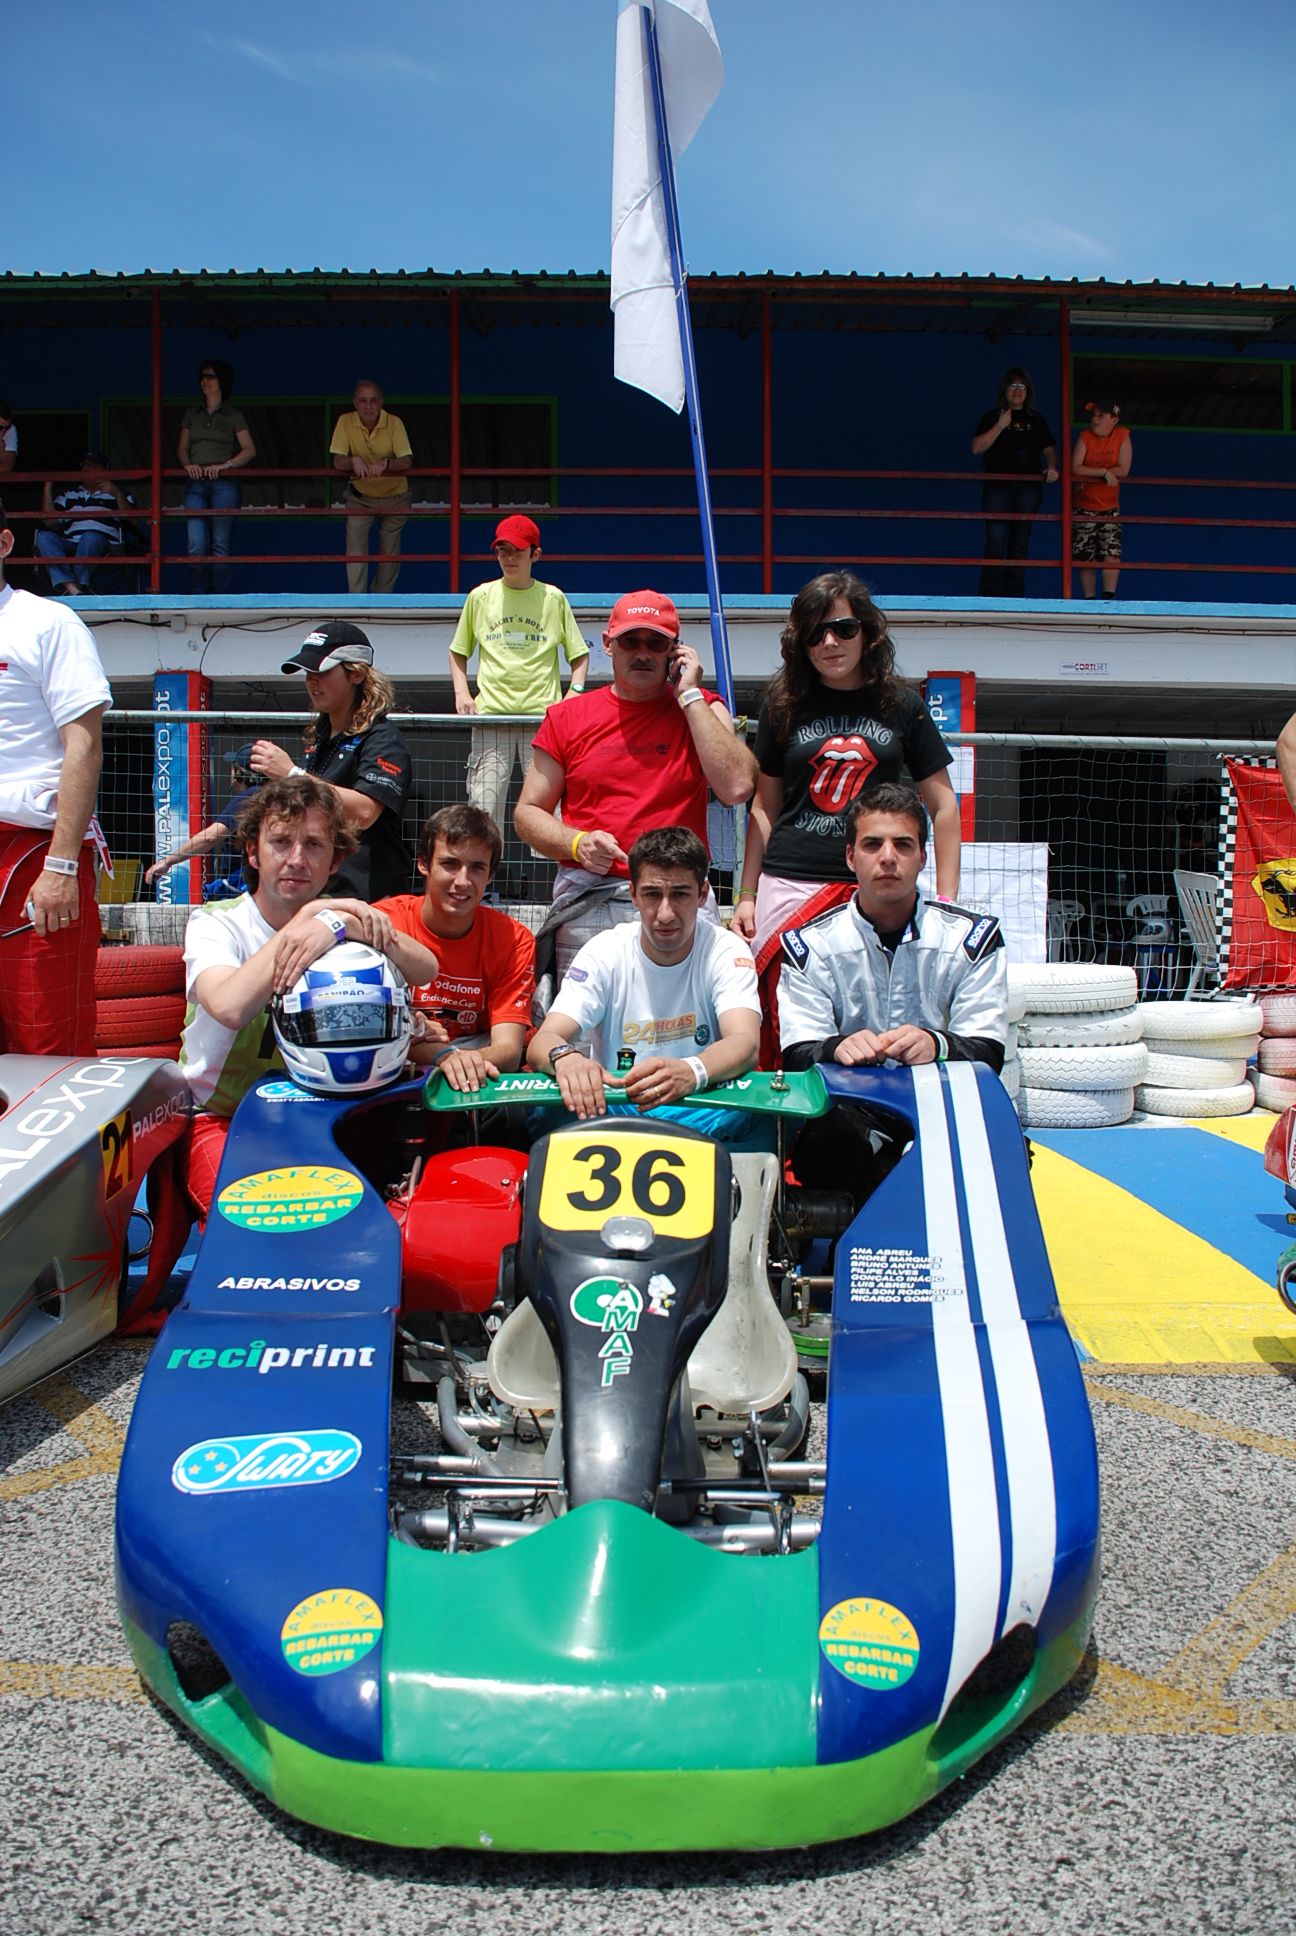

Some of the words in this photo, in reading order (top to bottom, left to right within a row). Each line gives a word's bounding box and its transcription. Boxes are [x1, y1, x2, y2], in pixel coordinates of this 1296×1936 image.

[626, 606, 660, 616] TOYOTA
[798, 716, 893, 746] ROLLING
[796, 810, 846, 836] STON
[784, 929, 806, 958] sparco
[967, 918, 992, 948] sparco
[434, 980, 480, 994] odafone
[459, 999, 476, 1009] Cup
[459, 1012, 476, 1022] MG
[622, 1022, 655, 1044] 24
[133, 1090, 186, 1144] PALexpo
[102, 1110, 134, 1200] 21
[228, 1170, 355, 1200] AMAFLEX
[566, 1144, 686, 1216] 36
[262, 1190, 322, 1198] discos
[224, 1198, 352, 1214] REBARBAR
[246, 1213, 327, 1226] CORTE
[218, 1277, 361, 1292] ABRASIVOS
[850, 1274, 904, 1282] GONÇALO
[166, 1340, 376, 1374] reciprint
[288, 1592, 377, 1632] AMAFLEX
[825, 1602, 913, 1642] AMAFLEX
[310, 1620, 352, 1629] discos
[285, 1632, 374, 1656] REBARBAR
[850, 1630, 891, 1642] discos
[300, 1648, 355, 1669] CORTE
[826, 1643, 914, 1668] REBARBAR
[844, 1660, 898, 1682] CORTE
